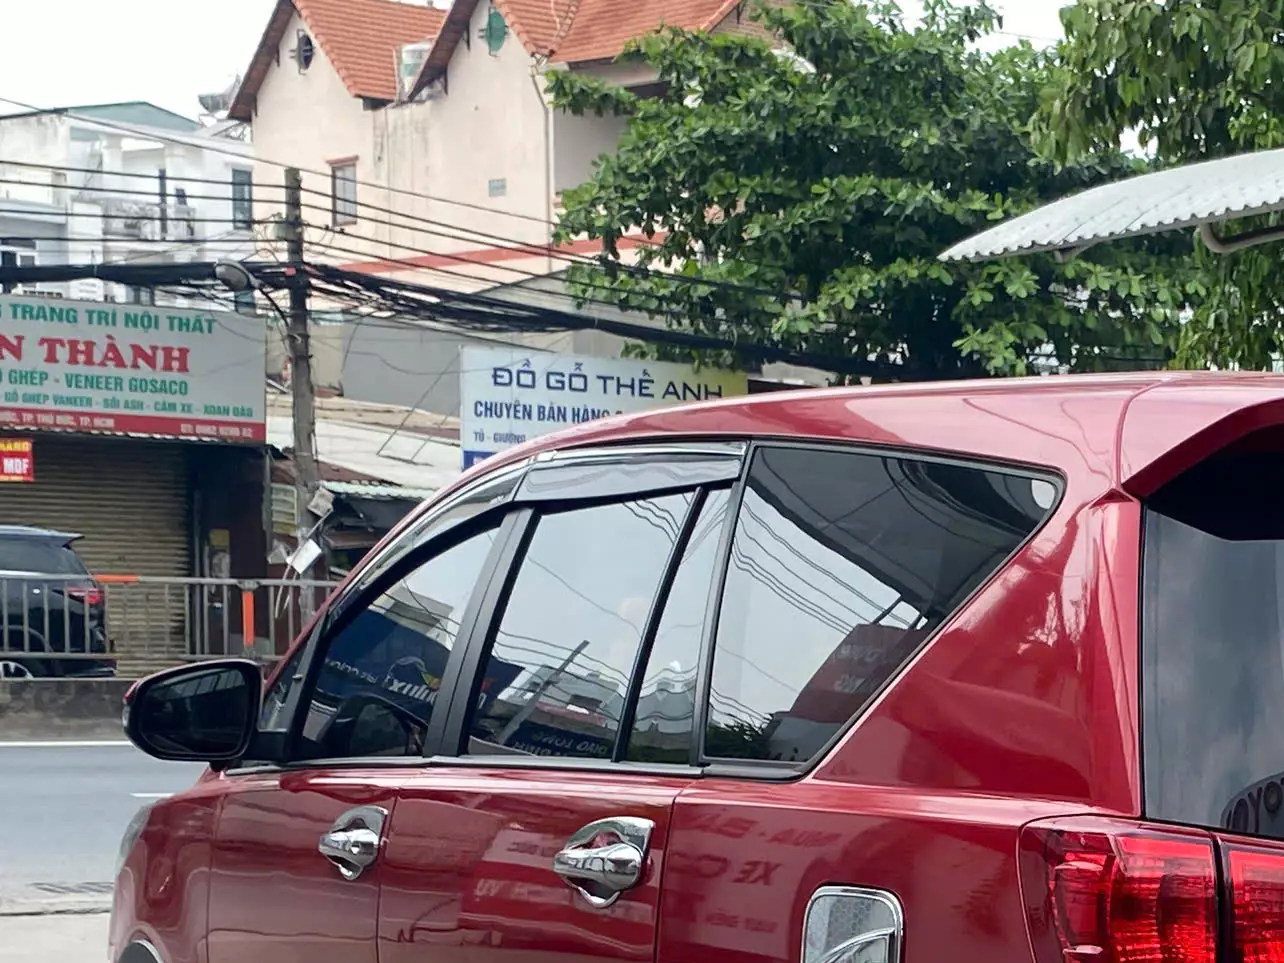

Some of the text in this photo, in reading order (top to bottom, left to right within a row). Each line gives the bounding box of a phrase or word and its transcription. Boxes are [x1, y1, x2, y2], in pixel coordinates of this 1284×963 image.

[9, 303, 78, 324] TRANG
[85, 306, 117, 327] TRÍ
[124, 310, 159, 333] NỘI
[166, 314, 216, 334] THẤT
[38, 333, 190, 373] THÀNH
[65, 373, 123, 392] VENEER
[128, 376, 188, 396] GOSACO
[491, 359, 536, 389] ĐỒ
[546, 362, 588, 392] GỖ
[662, 380, 722, 400] ANH
[474, 400, 532, 421] CHUYÊN
